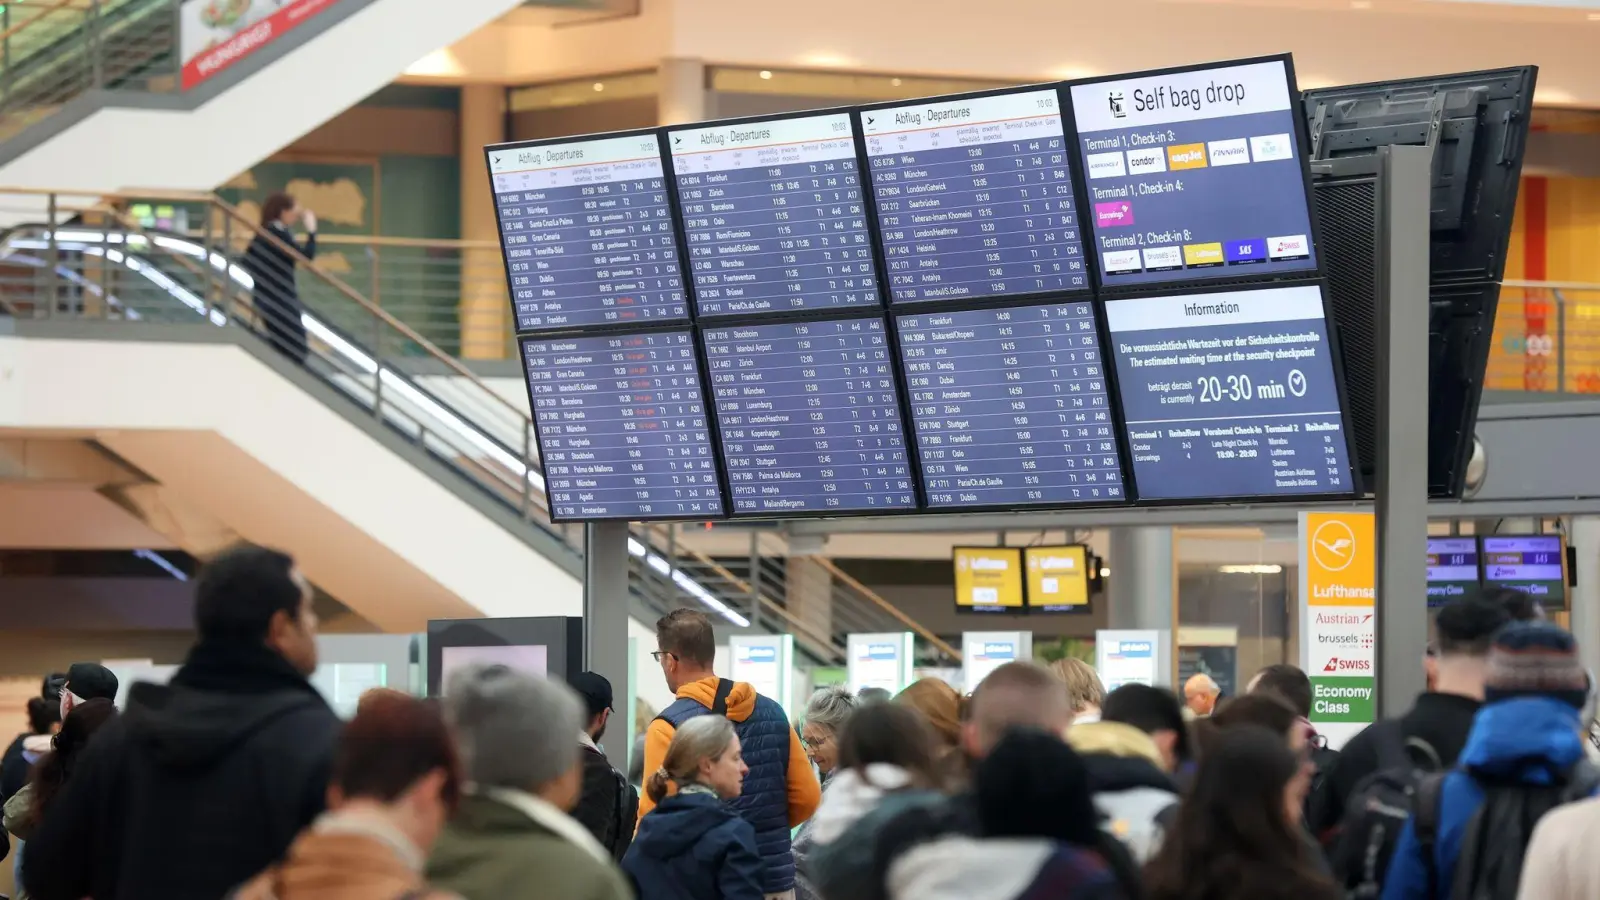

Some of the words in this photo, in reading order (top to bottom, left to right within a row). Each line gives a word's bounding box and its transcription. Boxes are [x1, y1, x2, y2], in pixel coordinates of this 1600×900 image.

[1133, 86, 1164, 111] Self
[1169, 85, 1200, 110] bag
[1206, 80, 1244, 105] drop
[895, 111, 920, 125] Abflug
[927, 108, 970, 121] Departures
[700, 132, 724, 145] Abflug
[730, 129, 770, 142] Departures
[1084, 135, 1120, 149] Terminal
[1121, 135, 1129, 147] 1,
[1130, 131, 1166, 145] Check-in
[1166, 130, 1175, 141] 3:
[518, 152, 540, 164] Abflug
[546, 149, 583, 161] Departures
[968, 148, 981, 156] 13:00
[1213, 147, 1244, 156] FINNAIR
[1131, 156, 1154, 166] condor
[903, 169, 927, 178] München
[970, 163, 984, 171] 13:00
[706, 173, 727, 182] Frankfurt
[906, 182, 946, 193] London/Gatwick
[1092, 184, 1128, 198] Terminal
[1129, 184, 1137, 196] 1,
[1138, 180, 1173, 194] Check-in
[1175, 179, 1183, 190] 4:
[710, 202, 734, 210] Barcelona
[908, 198, 939, 208] Saarbrücken
[1099, 210, 1123, 219] Eurowings
[913, 228, 957, 237] London/Heathrow
[1100, 233, 1136, 247] Terminal
[1137, 233, 1145, 245] 2,
[1146, 229, 1182, 243] Check-in
[1183, 229, 1192, 240] 8:
[916, 243, 936, 252] Helsinki
[983, 237, 997, 246] 13:25
[1238, 244, 1251, 254] SAS
[919, 258, 938, 267] Antalya
[922, 273, 940, 282] Antalya
[1184, 301, 1239, 315] Information
[929, 316, 952, 324] Frankfurt
[1120, 343, 1131, 353] Die
[1132, 340, 1187, 352] voraussichtliche
[1186, 337, 1221, 348] Wartezeit
[1234, 336, 1246, 346] der
[1247, 331, 1319, 345] Sicherheitskontrolle
[1129, 357, 1142, 366] The
[1144, 354, 1177, 366] estimated
[1179, 353, 1205, 365] waiting
[1206, 352, 1222, 362] time
[1224, 352, 1231, 361] at
[1232, 351, 1244, 360] the
[1246, 349, 1274, 360] security
[1275, 346, 1314, 359] checkpoint
[936, 361, 954, 370] Danzig
[939, 375, 954, 384] Dubai
[1147, 381, 1170, 392] beträgt
[1171, 380, 1192, 390] derzeit
[1197, 374, 1251, 402] 20-30
[1257, 379, 1285, 398] min
[942, 390, 970, 398] Amsterdam
[1160, 394, 1166, 403] is
[1167, 393, 1194, 404] currently
[946, 420, 969, 429] Stuttgart
[1264, 424, 1293, 432] Terminal
[750, 429, 780, 437] Kopenhagen
[1130, 430, 1157, 438] Terminal
[761, 485, 779, 494] Antalya
[1314, 584, 1376, 598] Lufthansa
[1316, 613, 1359, 624] Austrian
[1318, 634, 1358, 644] brussels
[1339, 660, 1370, 670] SWISS
[1314, 684, 1372, 700] Economy
[1314, 700, 1350, 713] Class
